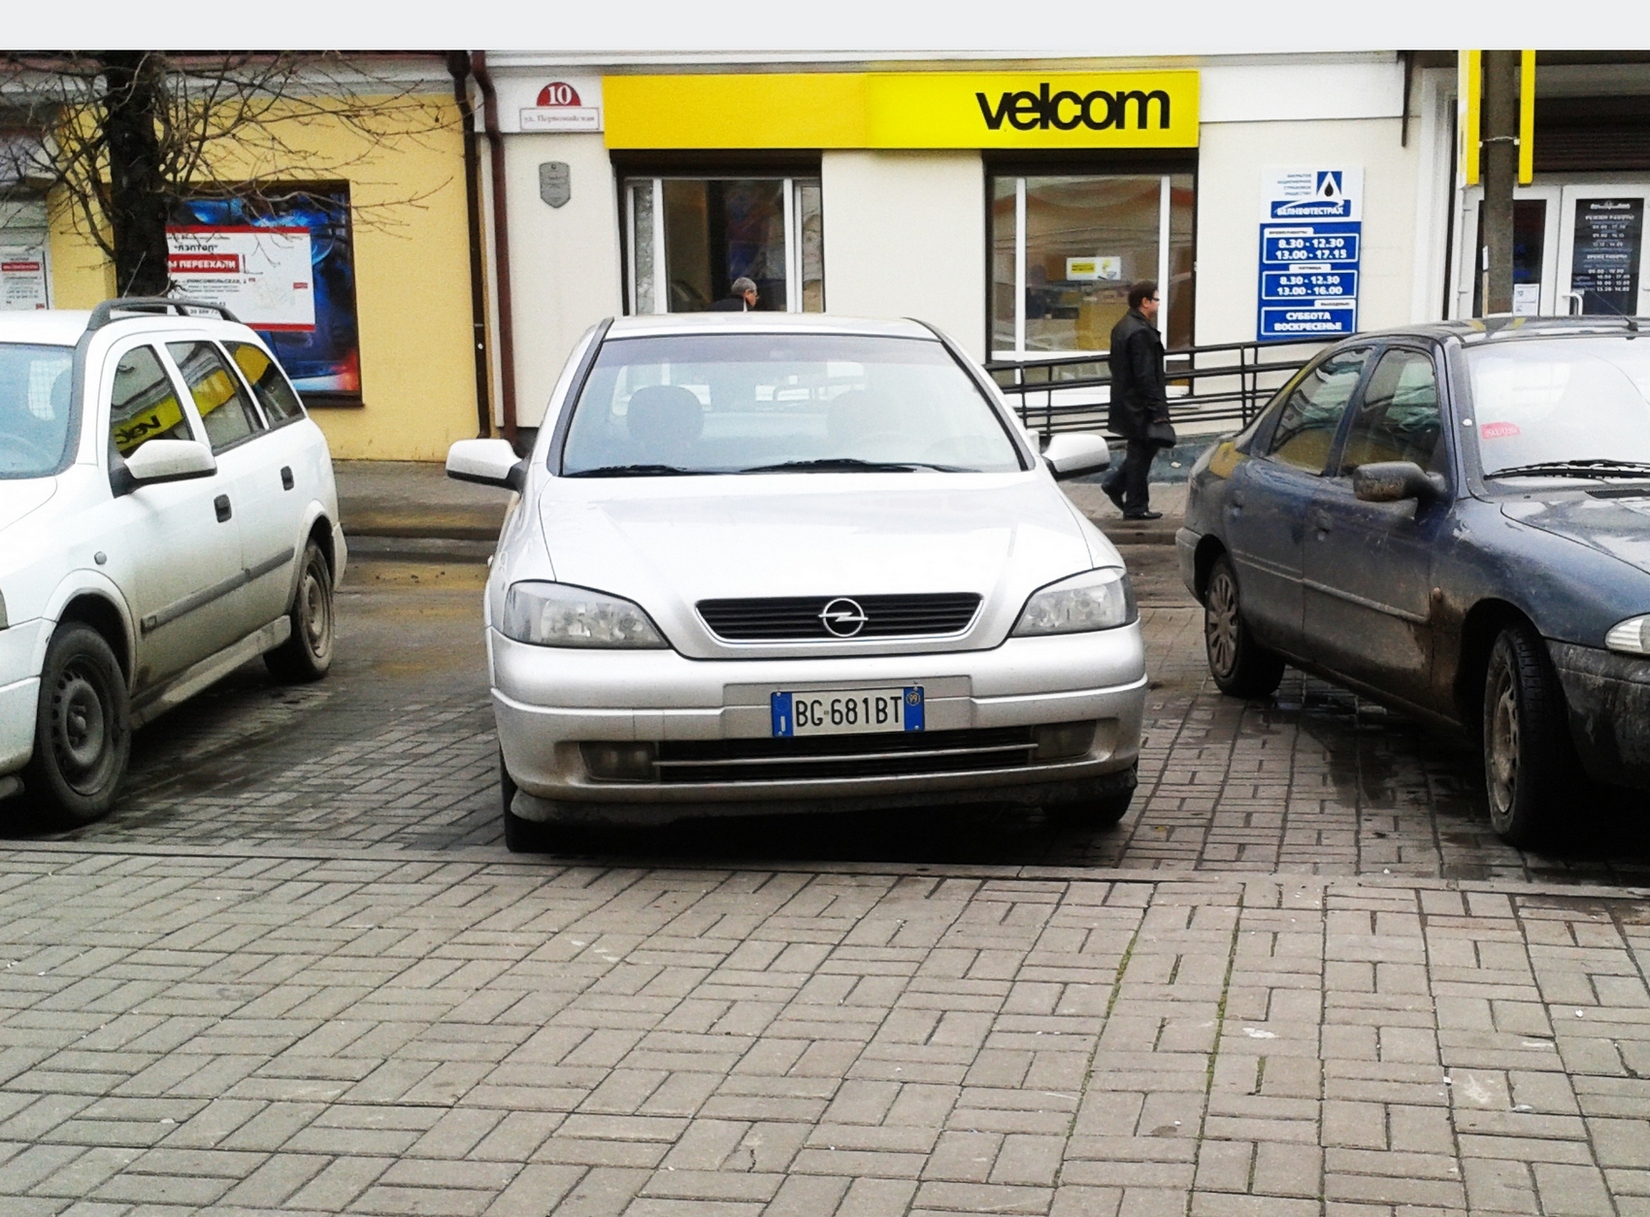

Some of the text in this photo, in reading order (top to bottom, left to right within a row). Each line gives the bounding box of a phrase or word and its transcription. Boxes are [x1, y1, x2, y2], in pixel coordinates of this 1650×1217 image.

[548, 85, 572, 105] 10
[975, 83, 1170, 130] velcom
[1278, 239, 1304, 248] 8.30
[1312, 238, 1344, 248] 12.30
[1275, 250, 1308, 260] 13.00
[1315, 249, 1347, 259] 17.15
[180, 260, 236, 269] ПЕРЕЕХАЛИ
[1279, 276, 1303, 285] 8.30
[1310, 275, 1340, 285] 12.30
[1277, 286, 1306, 296] 13.00
[1313, 286, 1343, 295] 16.00
[1286, 311, 1331, 320] СУББОТА
[1274, 322, 1342, 331] ВОСКРЕСЕНЬЕ
